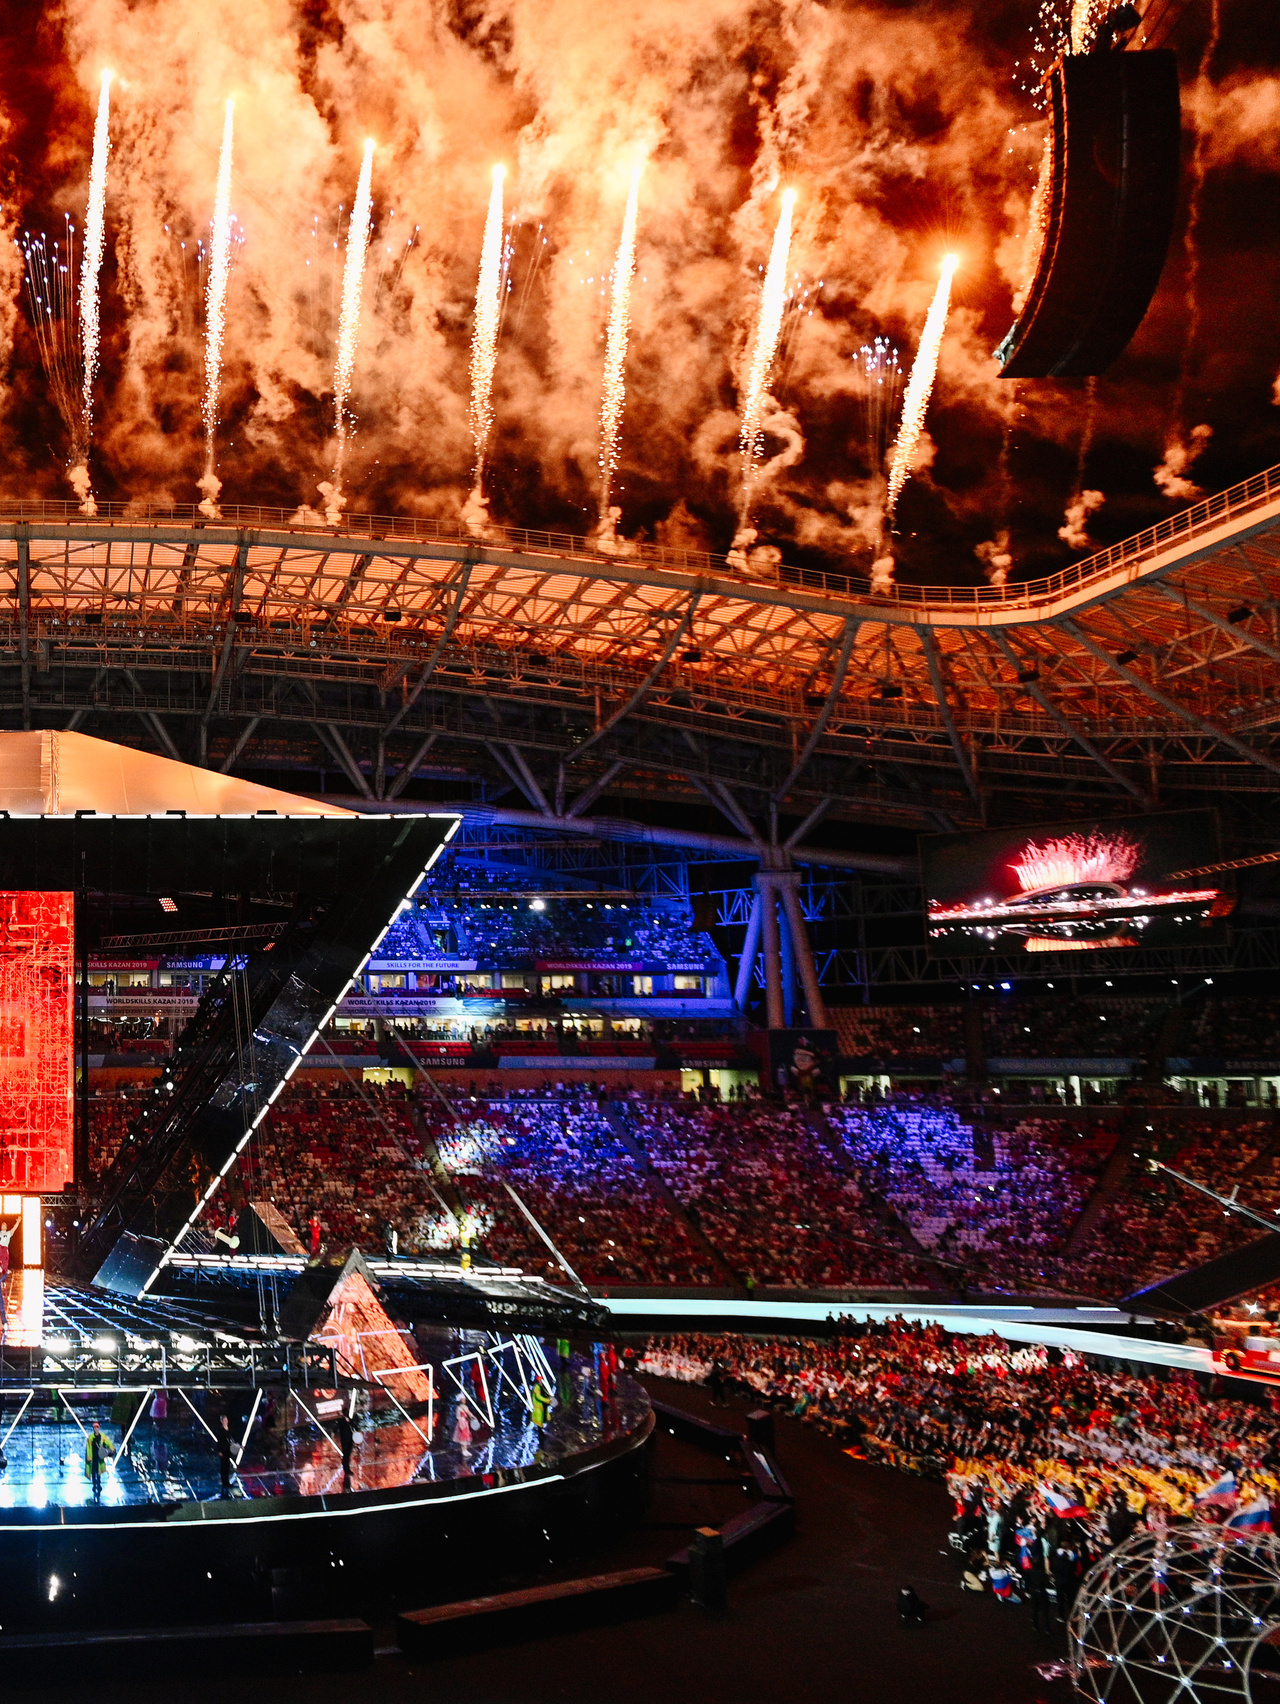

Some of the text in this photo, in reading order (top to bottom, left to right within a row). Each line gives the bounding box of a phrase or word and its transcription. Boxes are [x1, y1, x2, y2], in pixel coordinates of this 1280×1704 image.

[166, 961, 203, 969] SAMSUNG
[420, 1057, 465, 1066] SAMSUNG
[681, 1060, 728, 1068] SAMSUNG
